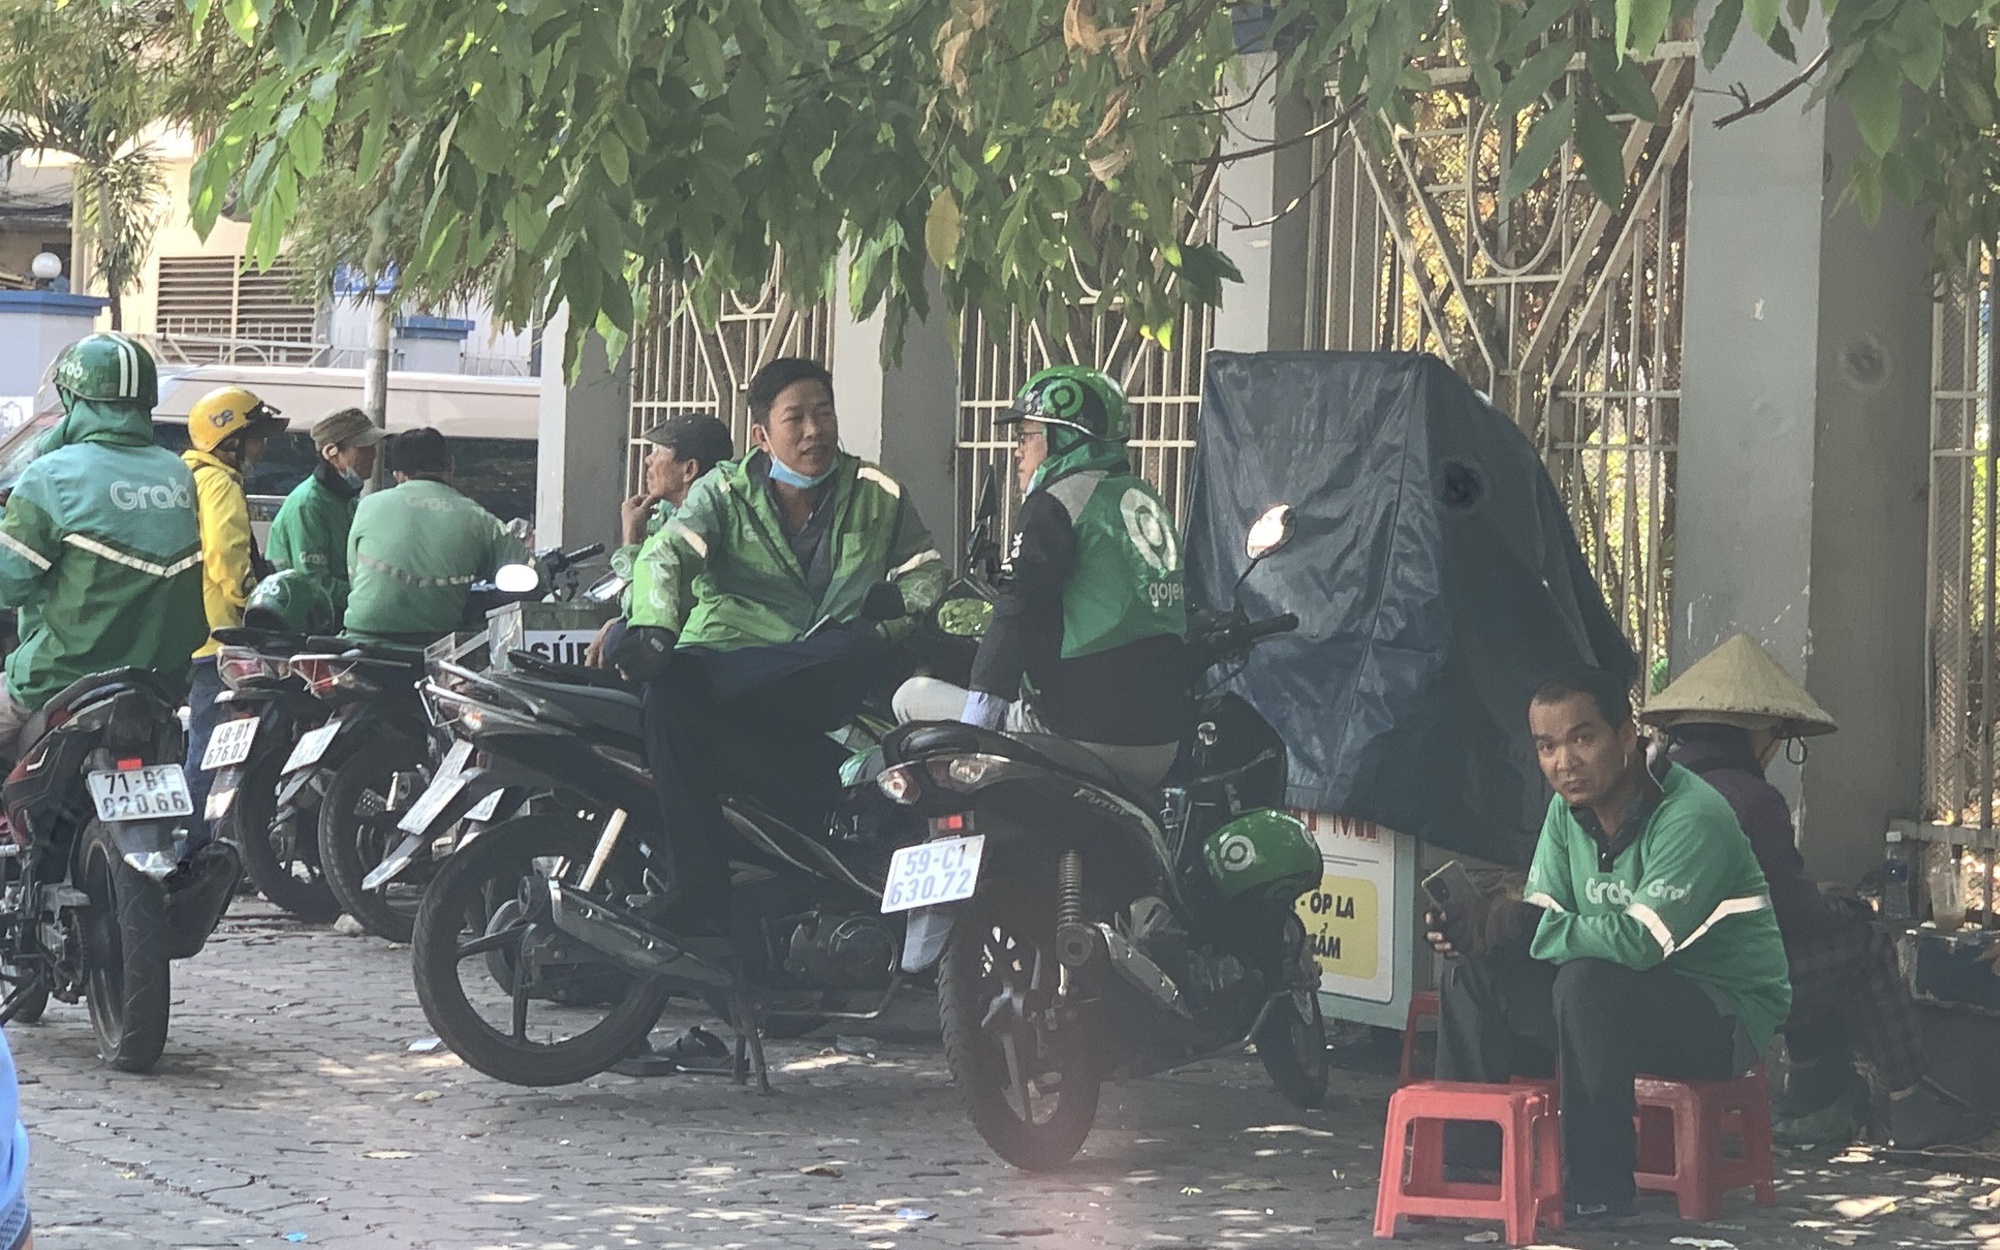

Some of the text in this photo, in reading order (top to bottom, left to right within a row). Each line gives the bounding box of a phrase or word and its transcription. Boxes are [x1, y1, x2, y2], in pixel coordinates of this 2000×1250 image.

[110, 477, 190, 511] Grab
[904, 844, 966, 876] 59-C1
[890, 869, 971, 905] 630.72
[1336, 895, 1354, 919] LA
